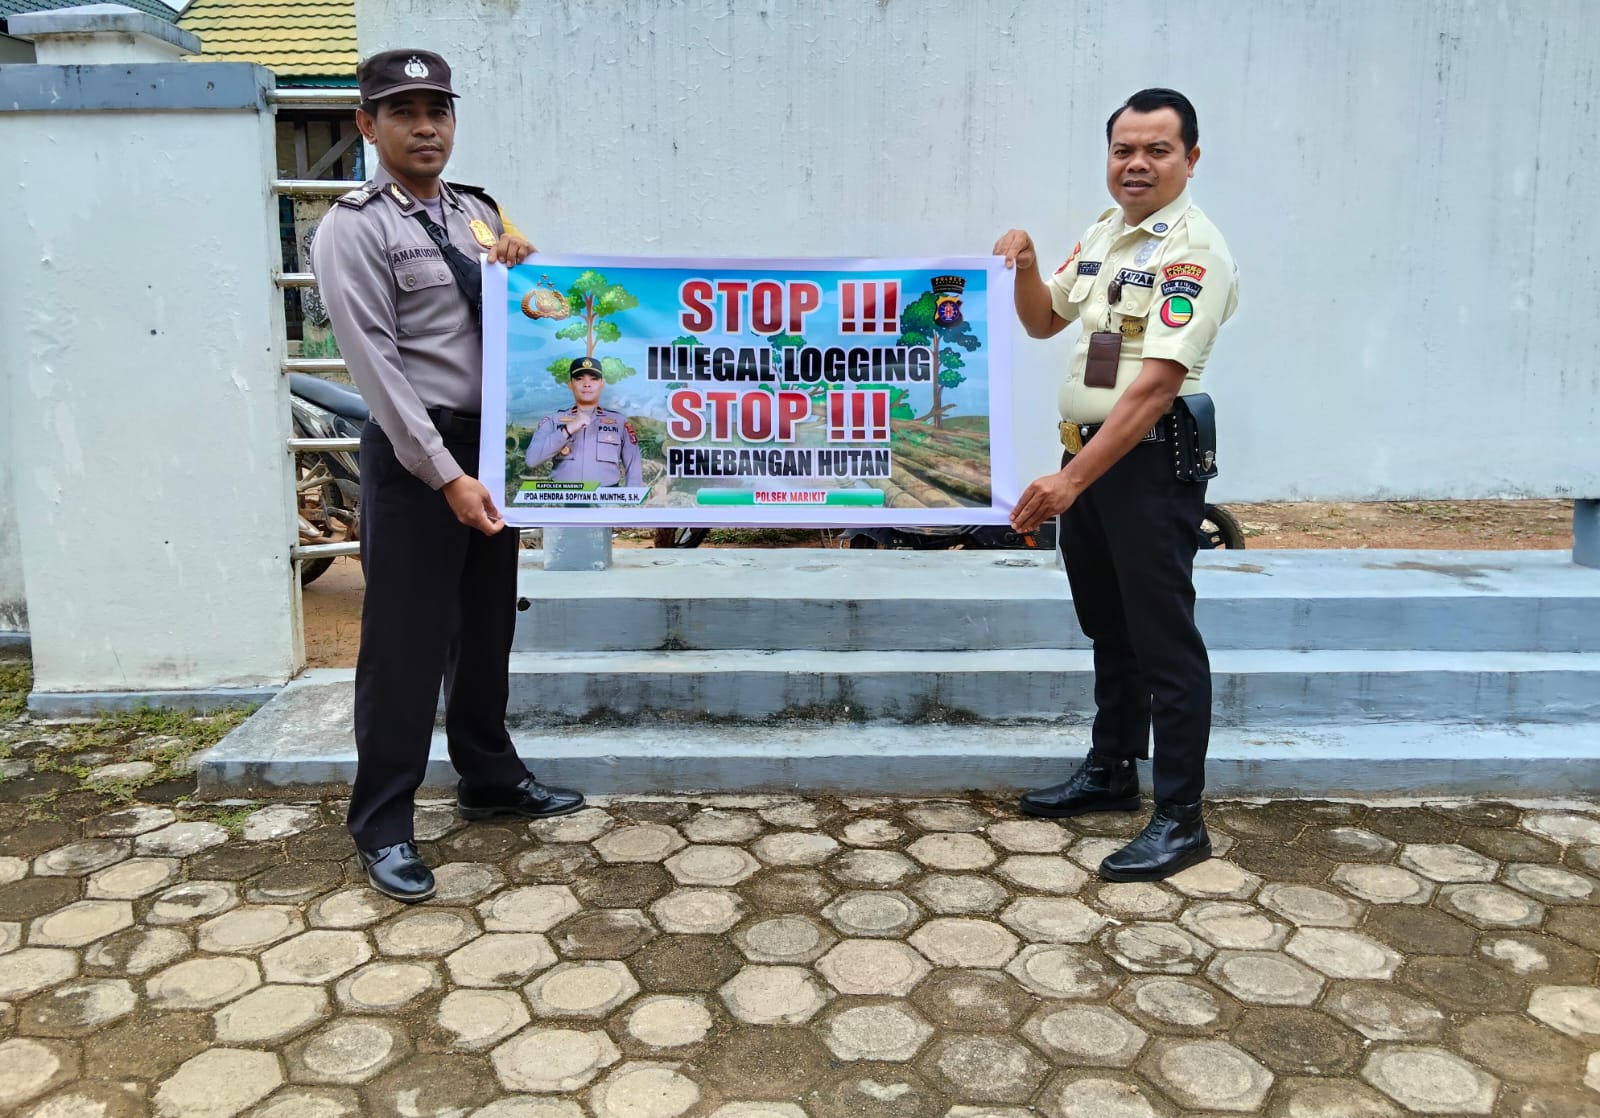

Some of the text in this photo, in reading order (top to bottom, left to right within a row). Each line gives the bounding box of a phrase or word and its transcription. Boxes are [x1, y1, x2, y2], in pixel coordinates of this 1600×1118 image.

[681, 280, 898, 333] STOP !!!
[647, 346, 931, 382] ILLEGAL LOGGING
[670, 391, 886, 440] STOP !!!
[669, 448, 889, 477] PENEBANGAN HUTAN
[523, 492, 640, 502] IPDA HENDRA SOPIYAN D. MUNTHE, S.H.
[755, 491, 826, 503] POLSEK MARIKIT
